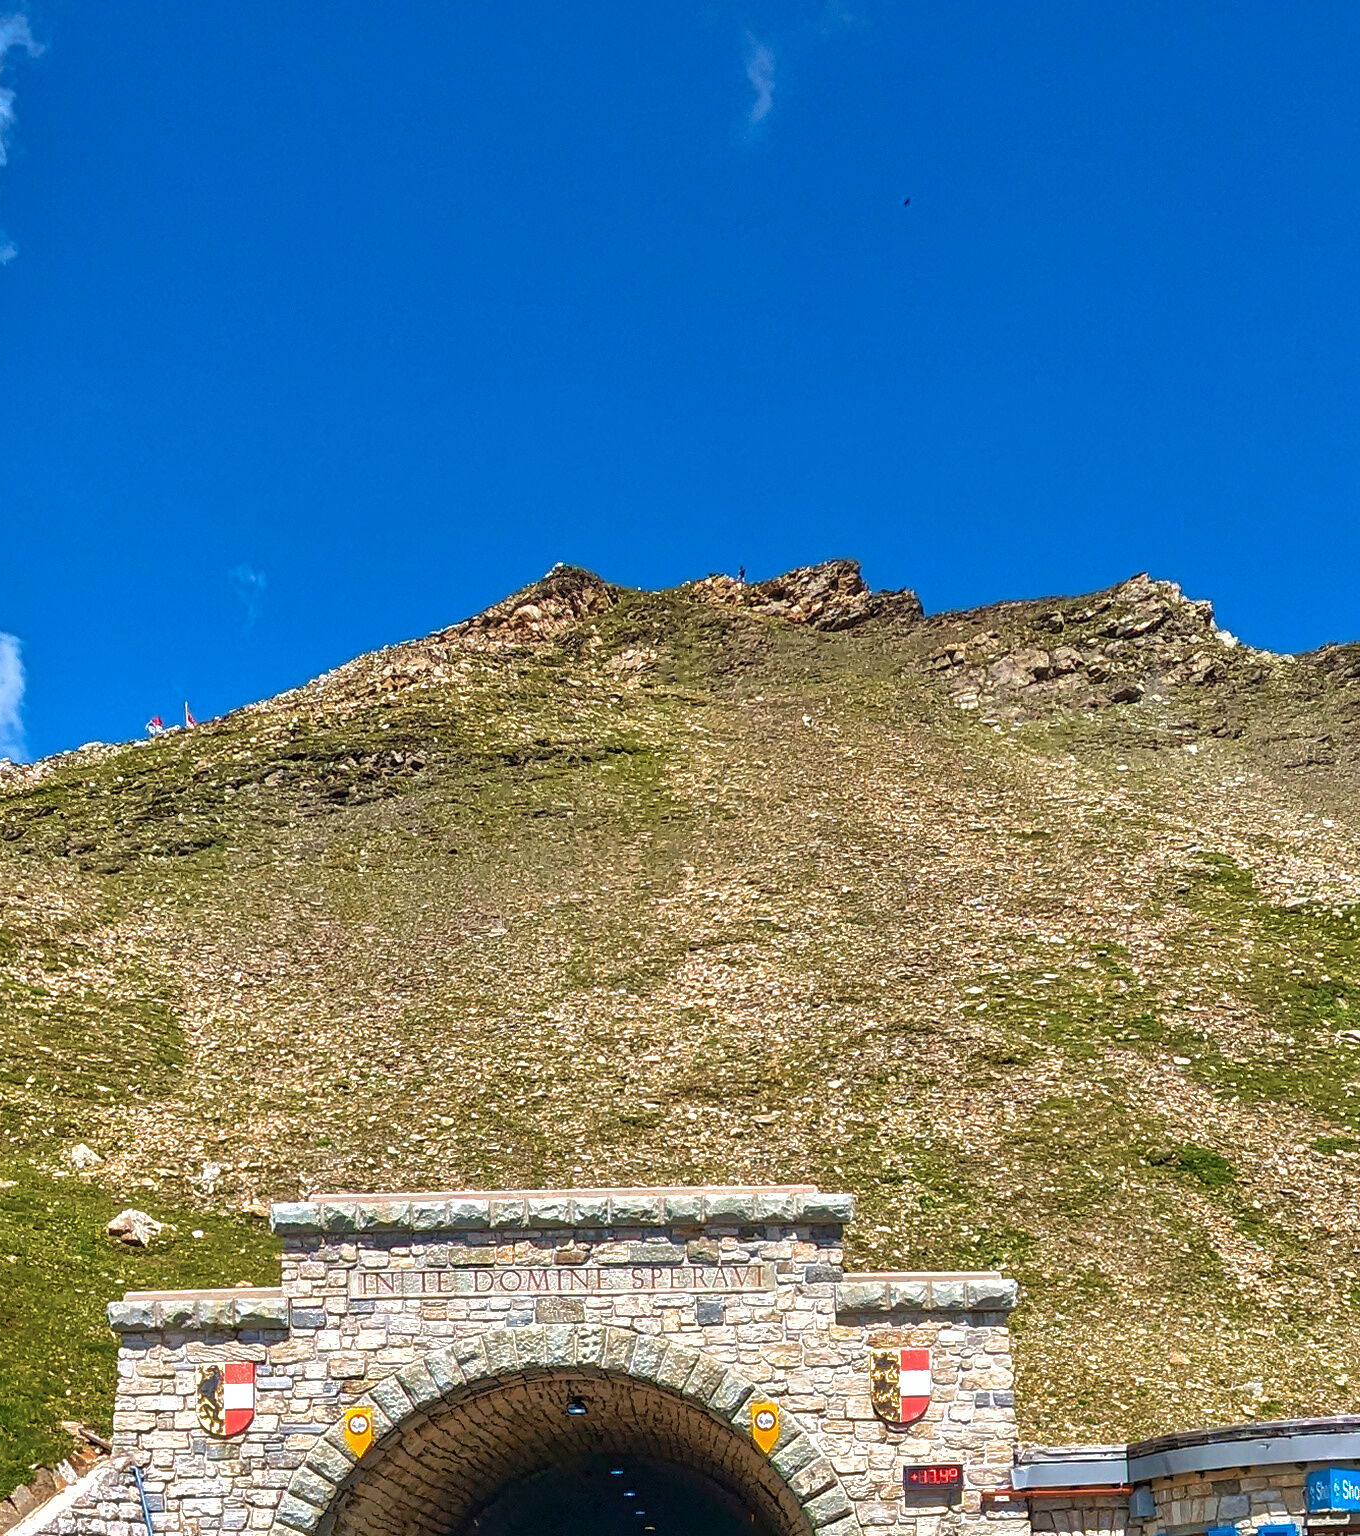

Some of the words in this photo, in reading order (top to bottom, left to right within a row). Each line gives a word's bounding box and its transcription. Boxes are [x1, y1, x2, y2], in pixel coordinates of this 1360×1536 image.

[360, 1271, 395, 1294] IN
[473, 1267, 614, 1292] DOMINE
[632, 1265, 765, 1290] SPERAVI
